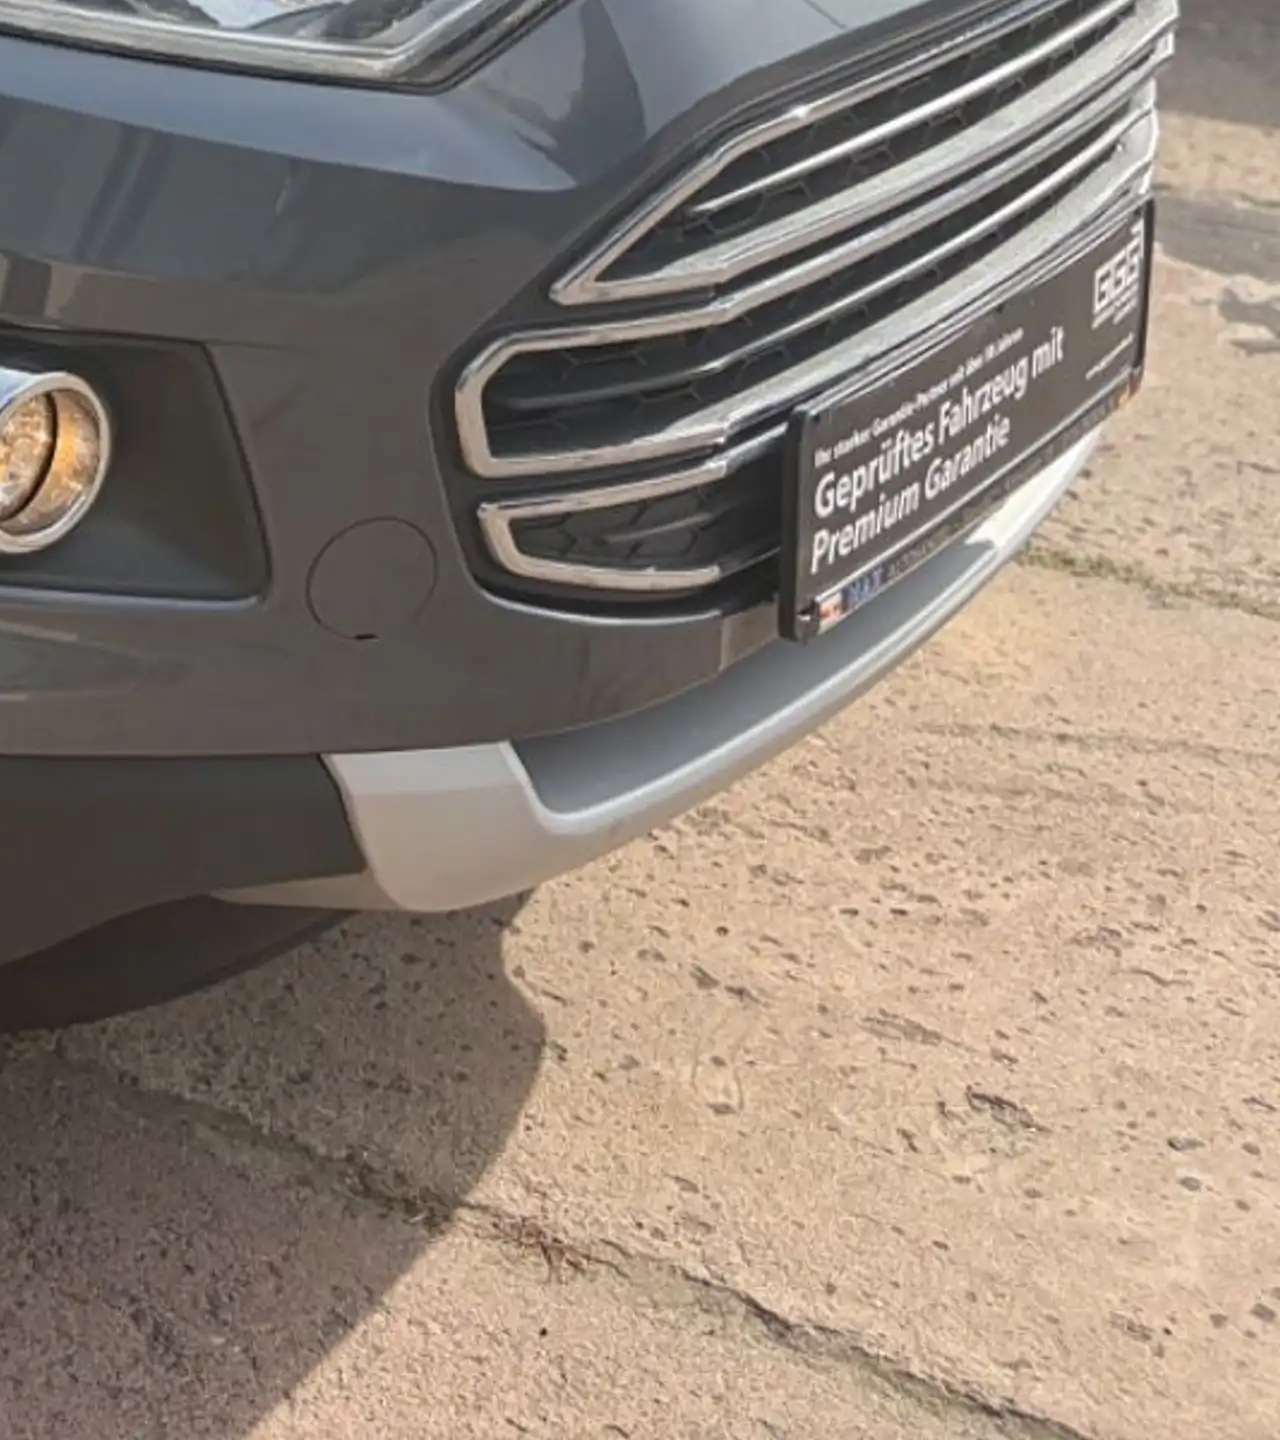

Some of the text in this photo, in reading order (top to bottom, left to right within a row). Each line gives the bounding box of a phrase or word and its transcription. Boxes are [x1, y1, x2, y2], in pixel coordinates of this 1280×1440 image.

[810, 481, 920, 575] Premium
[924, 413, 1011, 499] Garantie
[814, 421, 936, 518] Geprüftes
[938, 356, 1028, 446] Fahrzeug
[1031, 326, 1064, 379] mit
